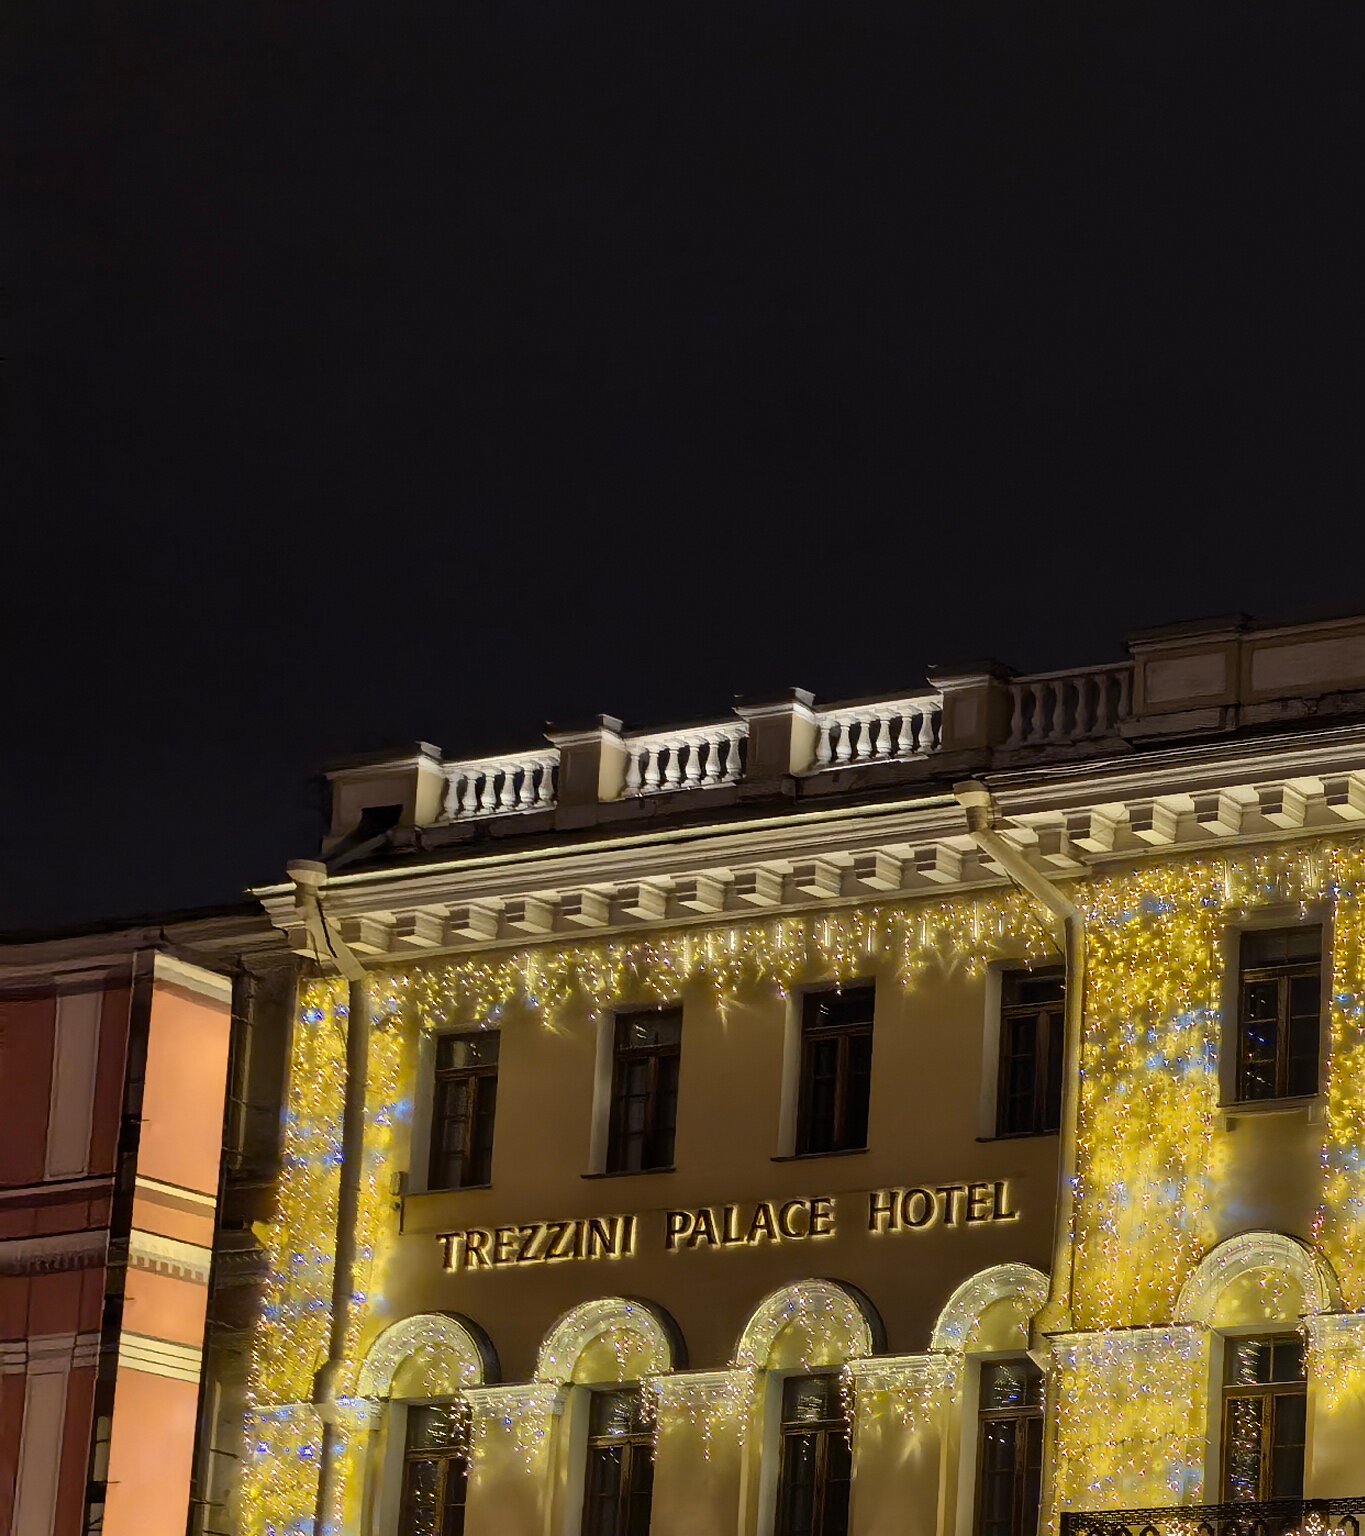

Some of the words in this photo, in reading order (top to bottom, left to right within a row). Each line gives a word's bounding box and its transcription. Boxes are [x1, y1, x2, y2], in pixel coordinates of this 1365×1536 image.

[436, 1214, 637, 1272] TREZZINI
[666, 1197, 836, 1252] PALACE
[868, 1180, 1019, 1233] HOTEL
